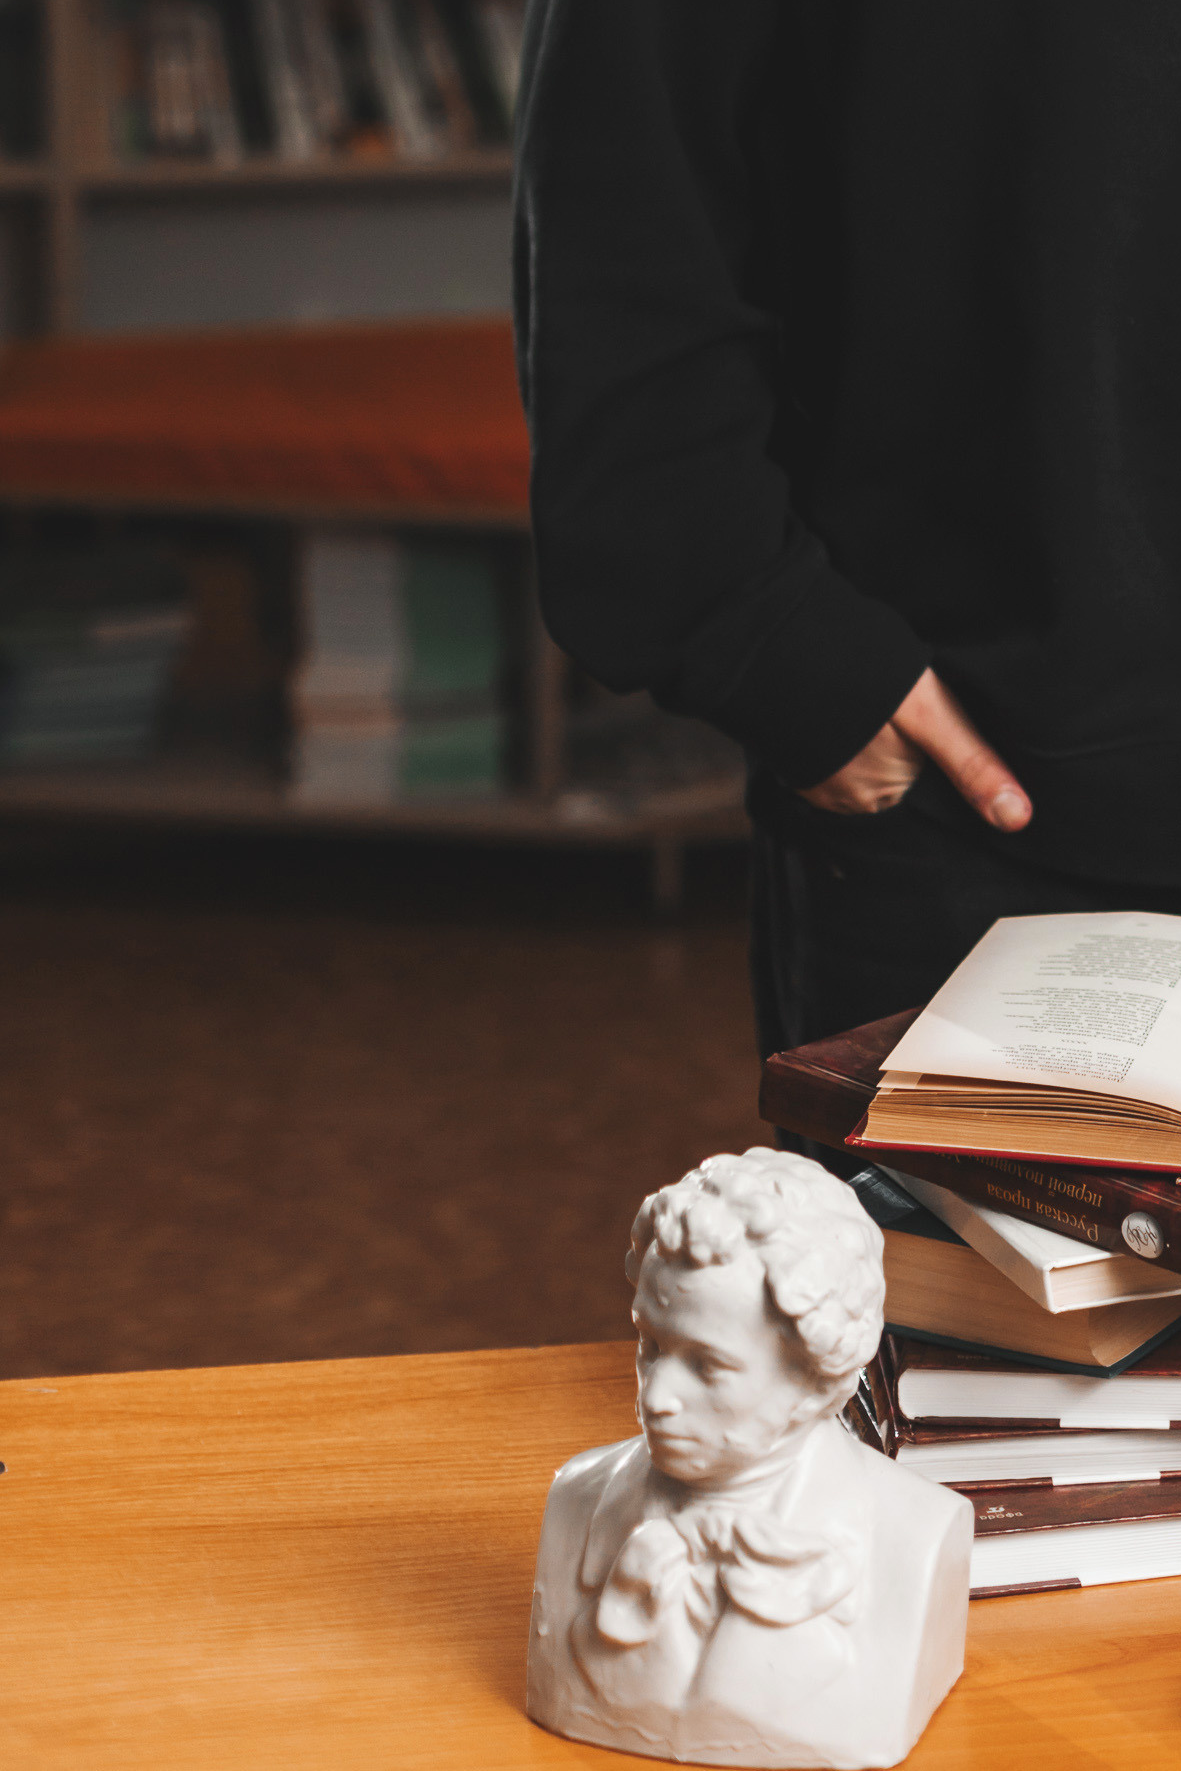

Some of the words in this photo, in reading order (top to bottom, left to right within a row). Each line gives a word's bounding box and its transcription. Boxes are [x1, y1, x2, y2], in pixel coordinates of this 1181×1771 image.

[987, 1183, 1031, 1210] проза
[1049, 1177, 1103, 1208] первой
[1036, 1201, 1099, 1242] Русская
